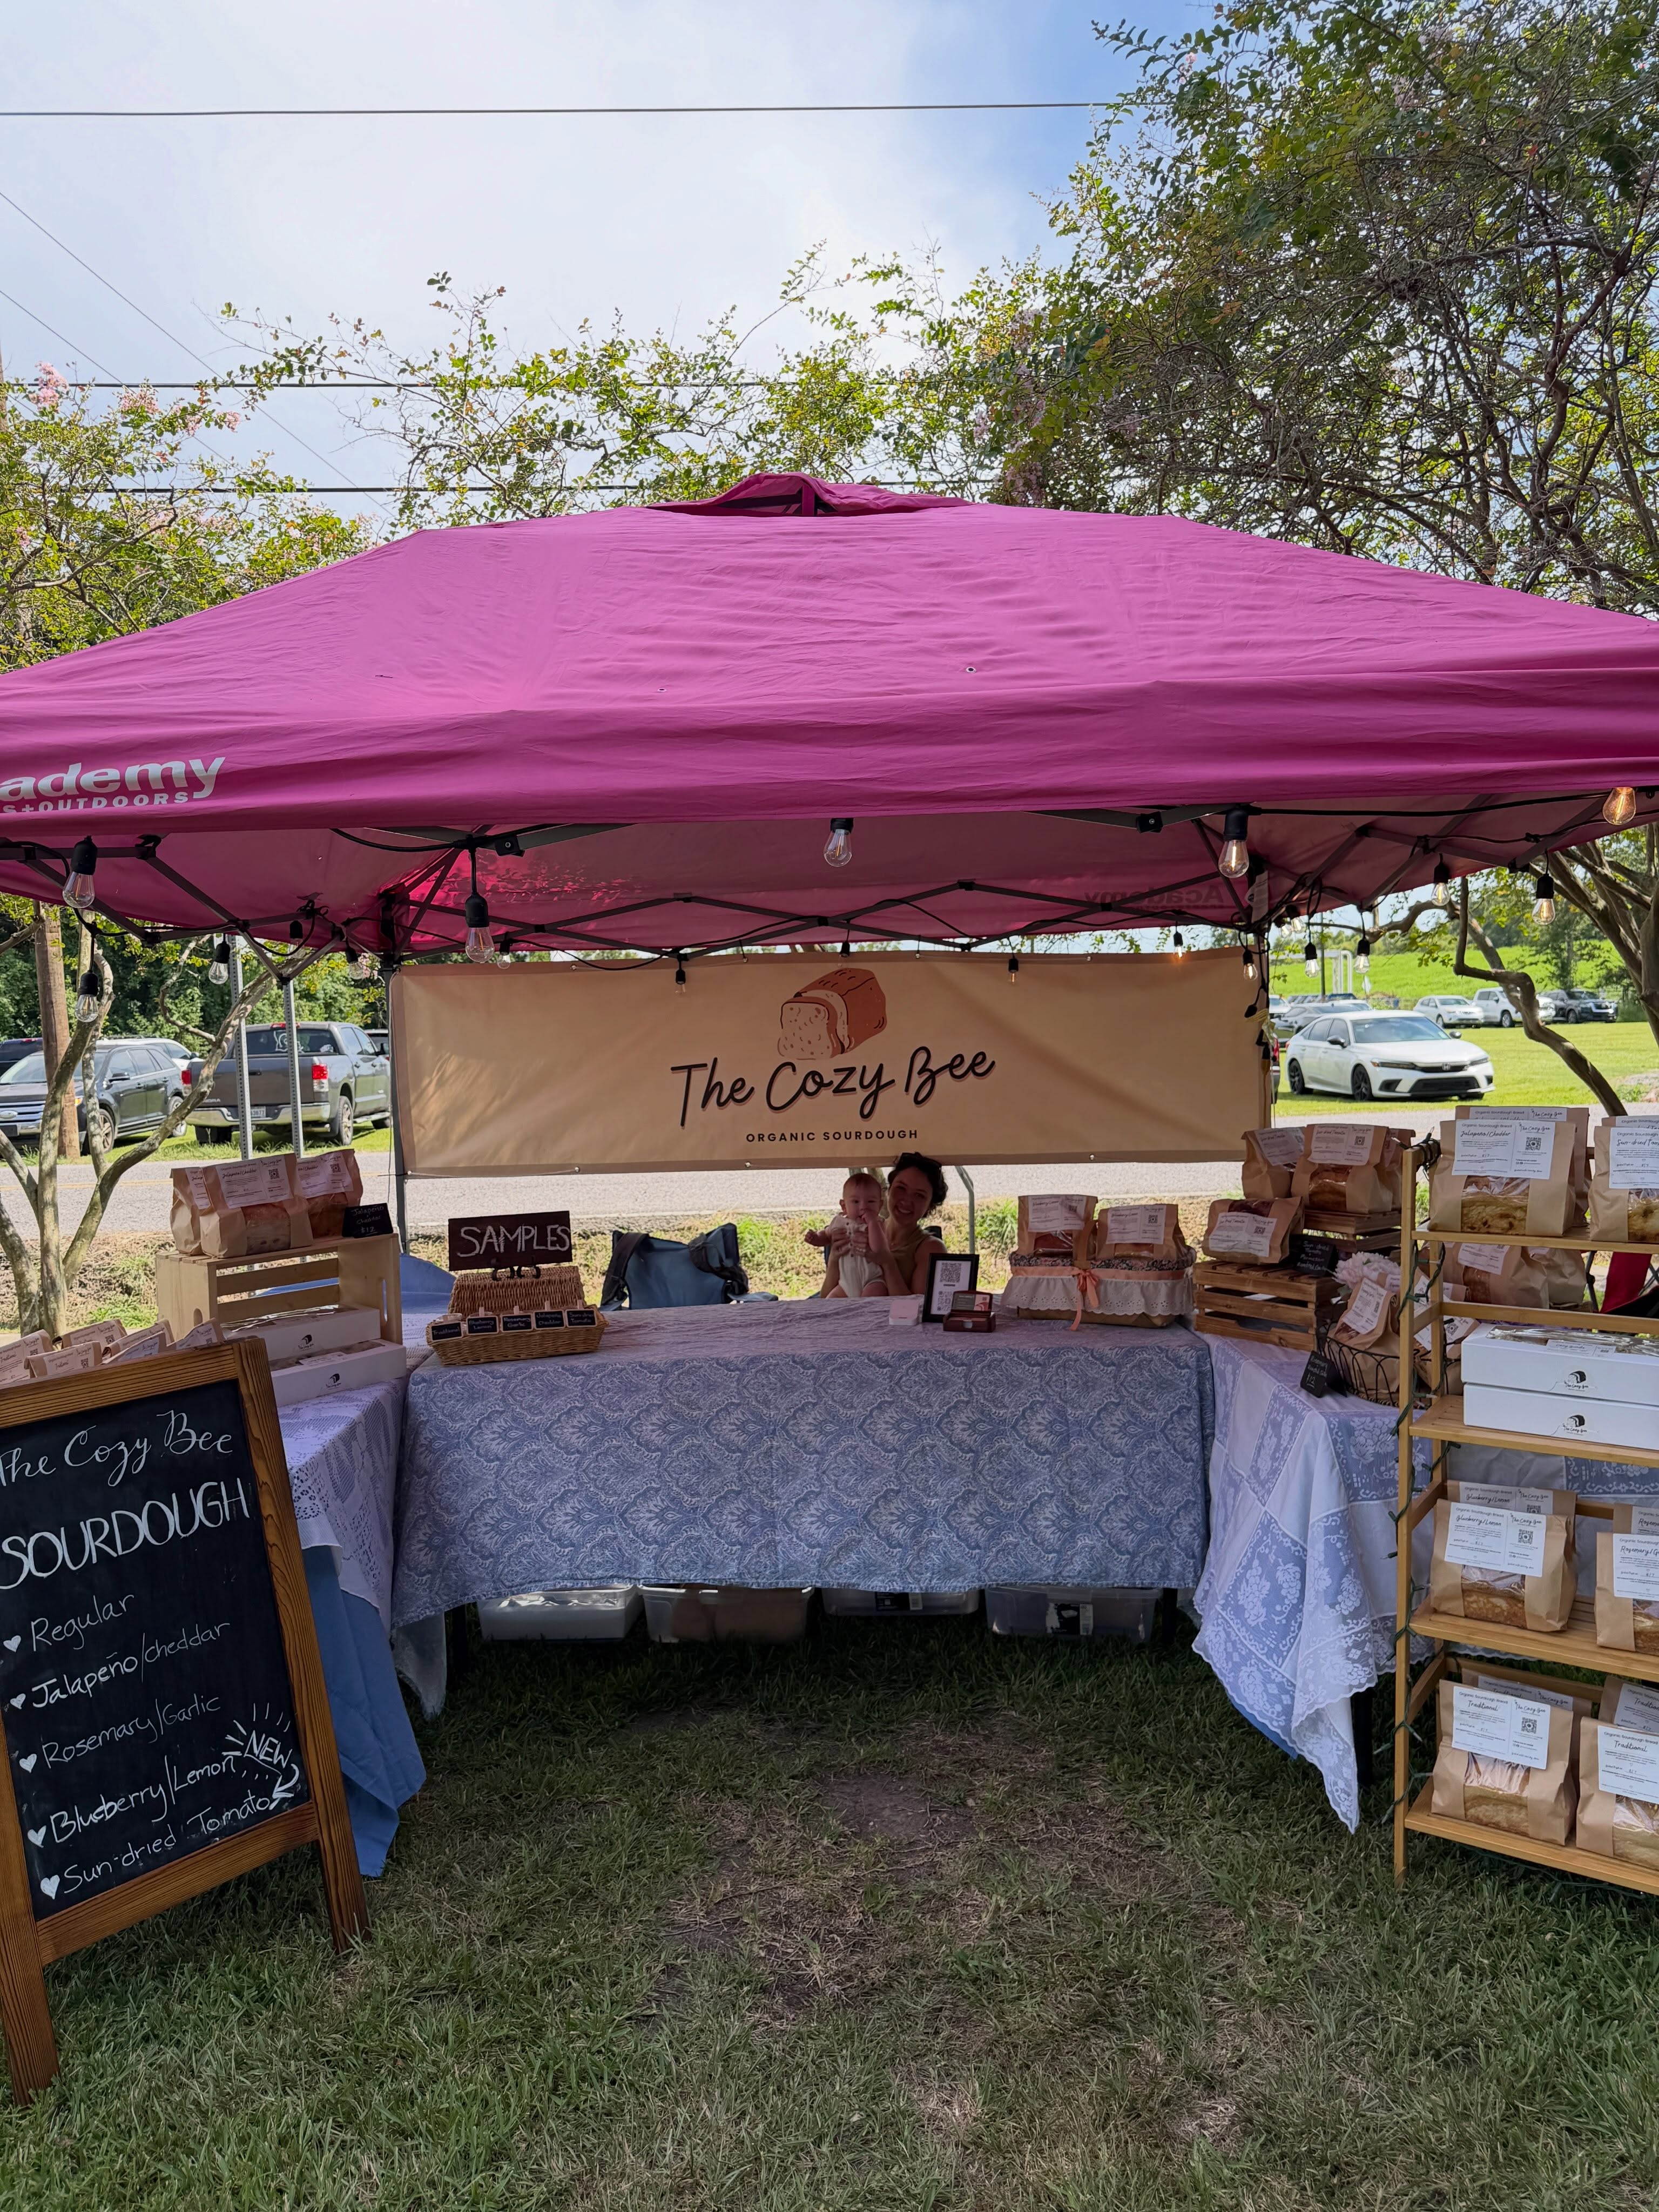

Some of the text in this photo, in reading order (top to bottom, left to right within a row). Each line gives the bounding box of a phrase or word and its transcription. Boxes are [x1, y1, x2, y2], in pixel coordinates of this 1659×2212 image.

[0, 757, 225, 801] ademy
[671, 1046, 996, 1128] The Cozy Bee
[746, 1129, 918, 1143] ORGANIC SOURDOUGH
[457, 1224, 570, 1257] SAMPLES
[0, 1410, 233, 1487] The Cozy Bee
[0, 1477, 250, 1590] SOURDOUGH
[1456, 1515, 1501, 1526] Blueberry/Lemon
[31, 1595, 134, 1651] Regular
[1468, 1700, 1499, 1711] Traditional
[43, 1693, 221, 1769] Rosemary/Garlic
[243, 1730, 292, 1768] NEW
[1614, 1739, 1648, 1752] Traditional
[50, 1755, 236, 1843] Blueberry/Lemon
[64, 1790, 272, 1894] Sun-dried Tomato
